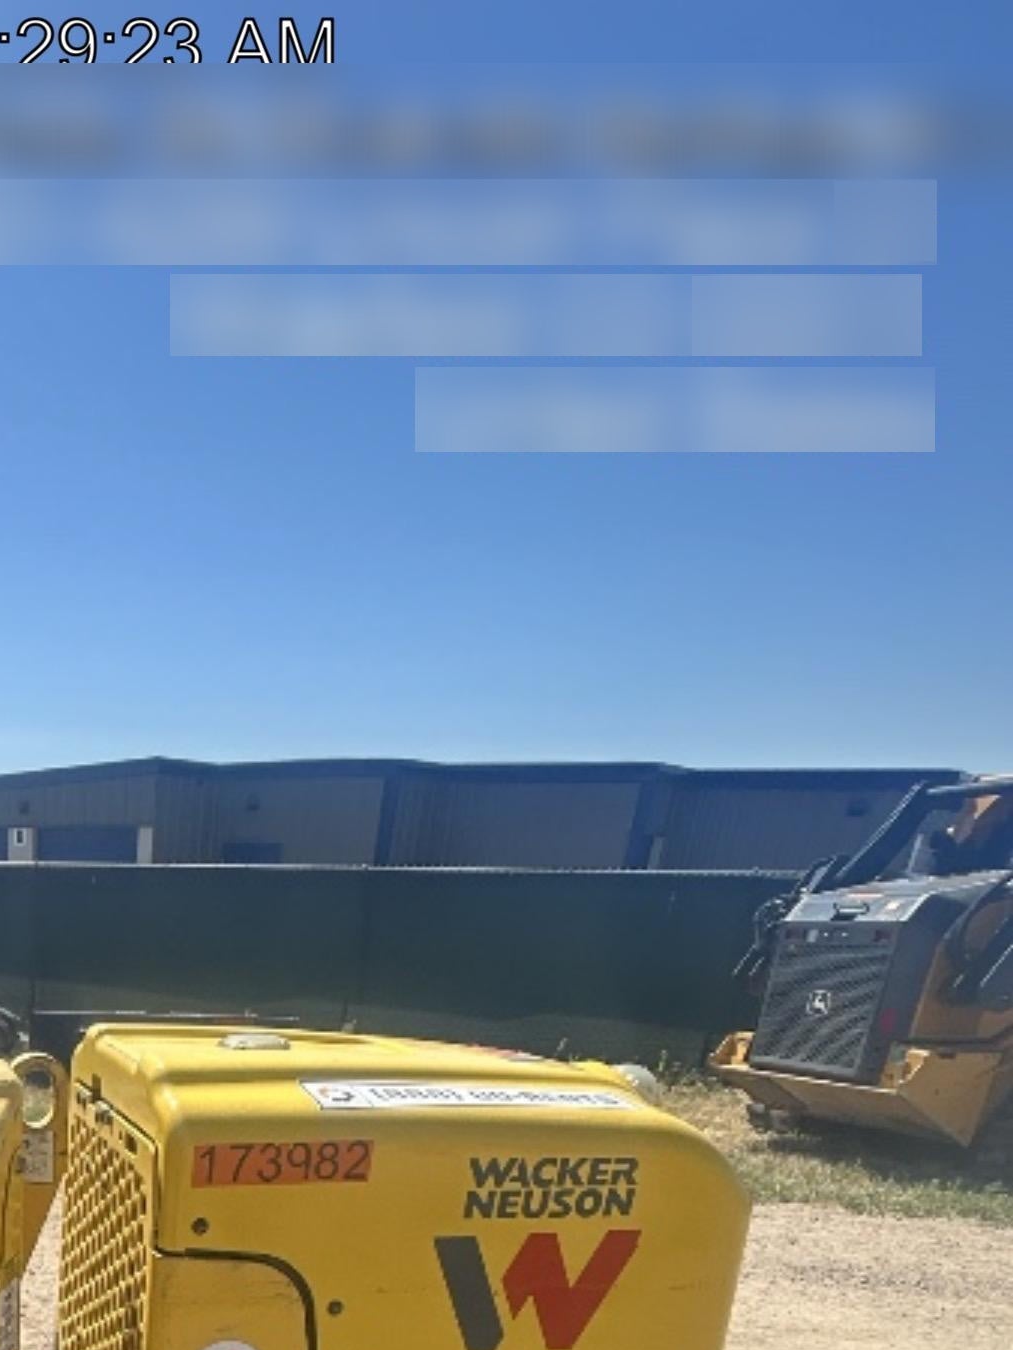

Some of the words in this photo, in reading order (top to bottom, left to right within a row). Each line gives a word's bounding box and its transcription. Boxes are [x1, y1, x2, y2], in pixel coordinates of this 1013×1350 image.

[199, 1139, 370, 1185] 173982
[468, 1156, 640, 1188] WACKER
[463, 1187, 637, 1219] NEUSON
